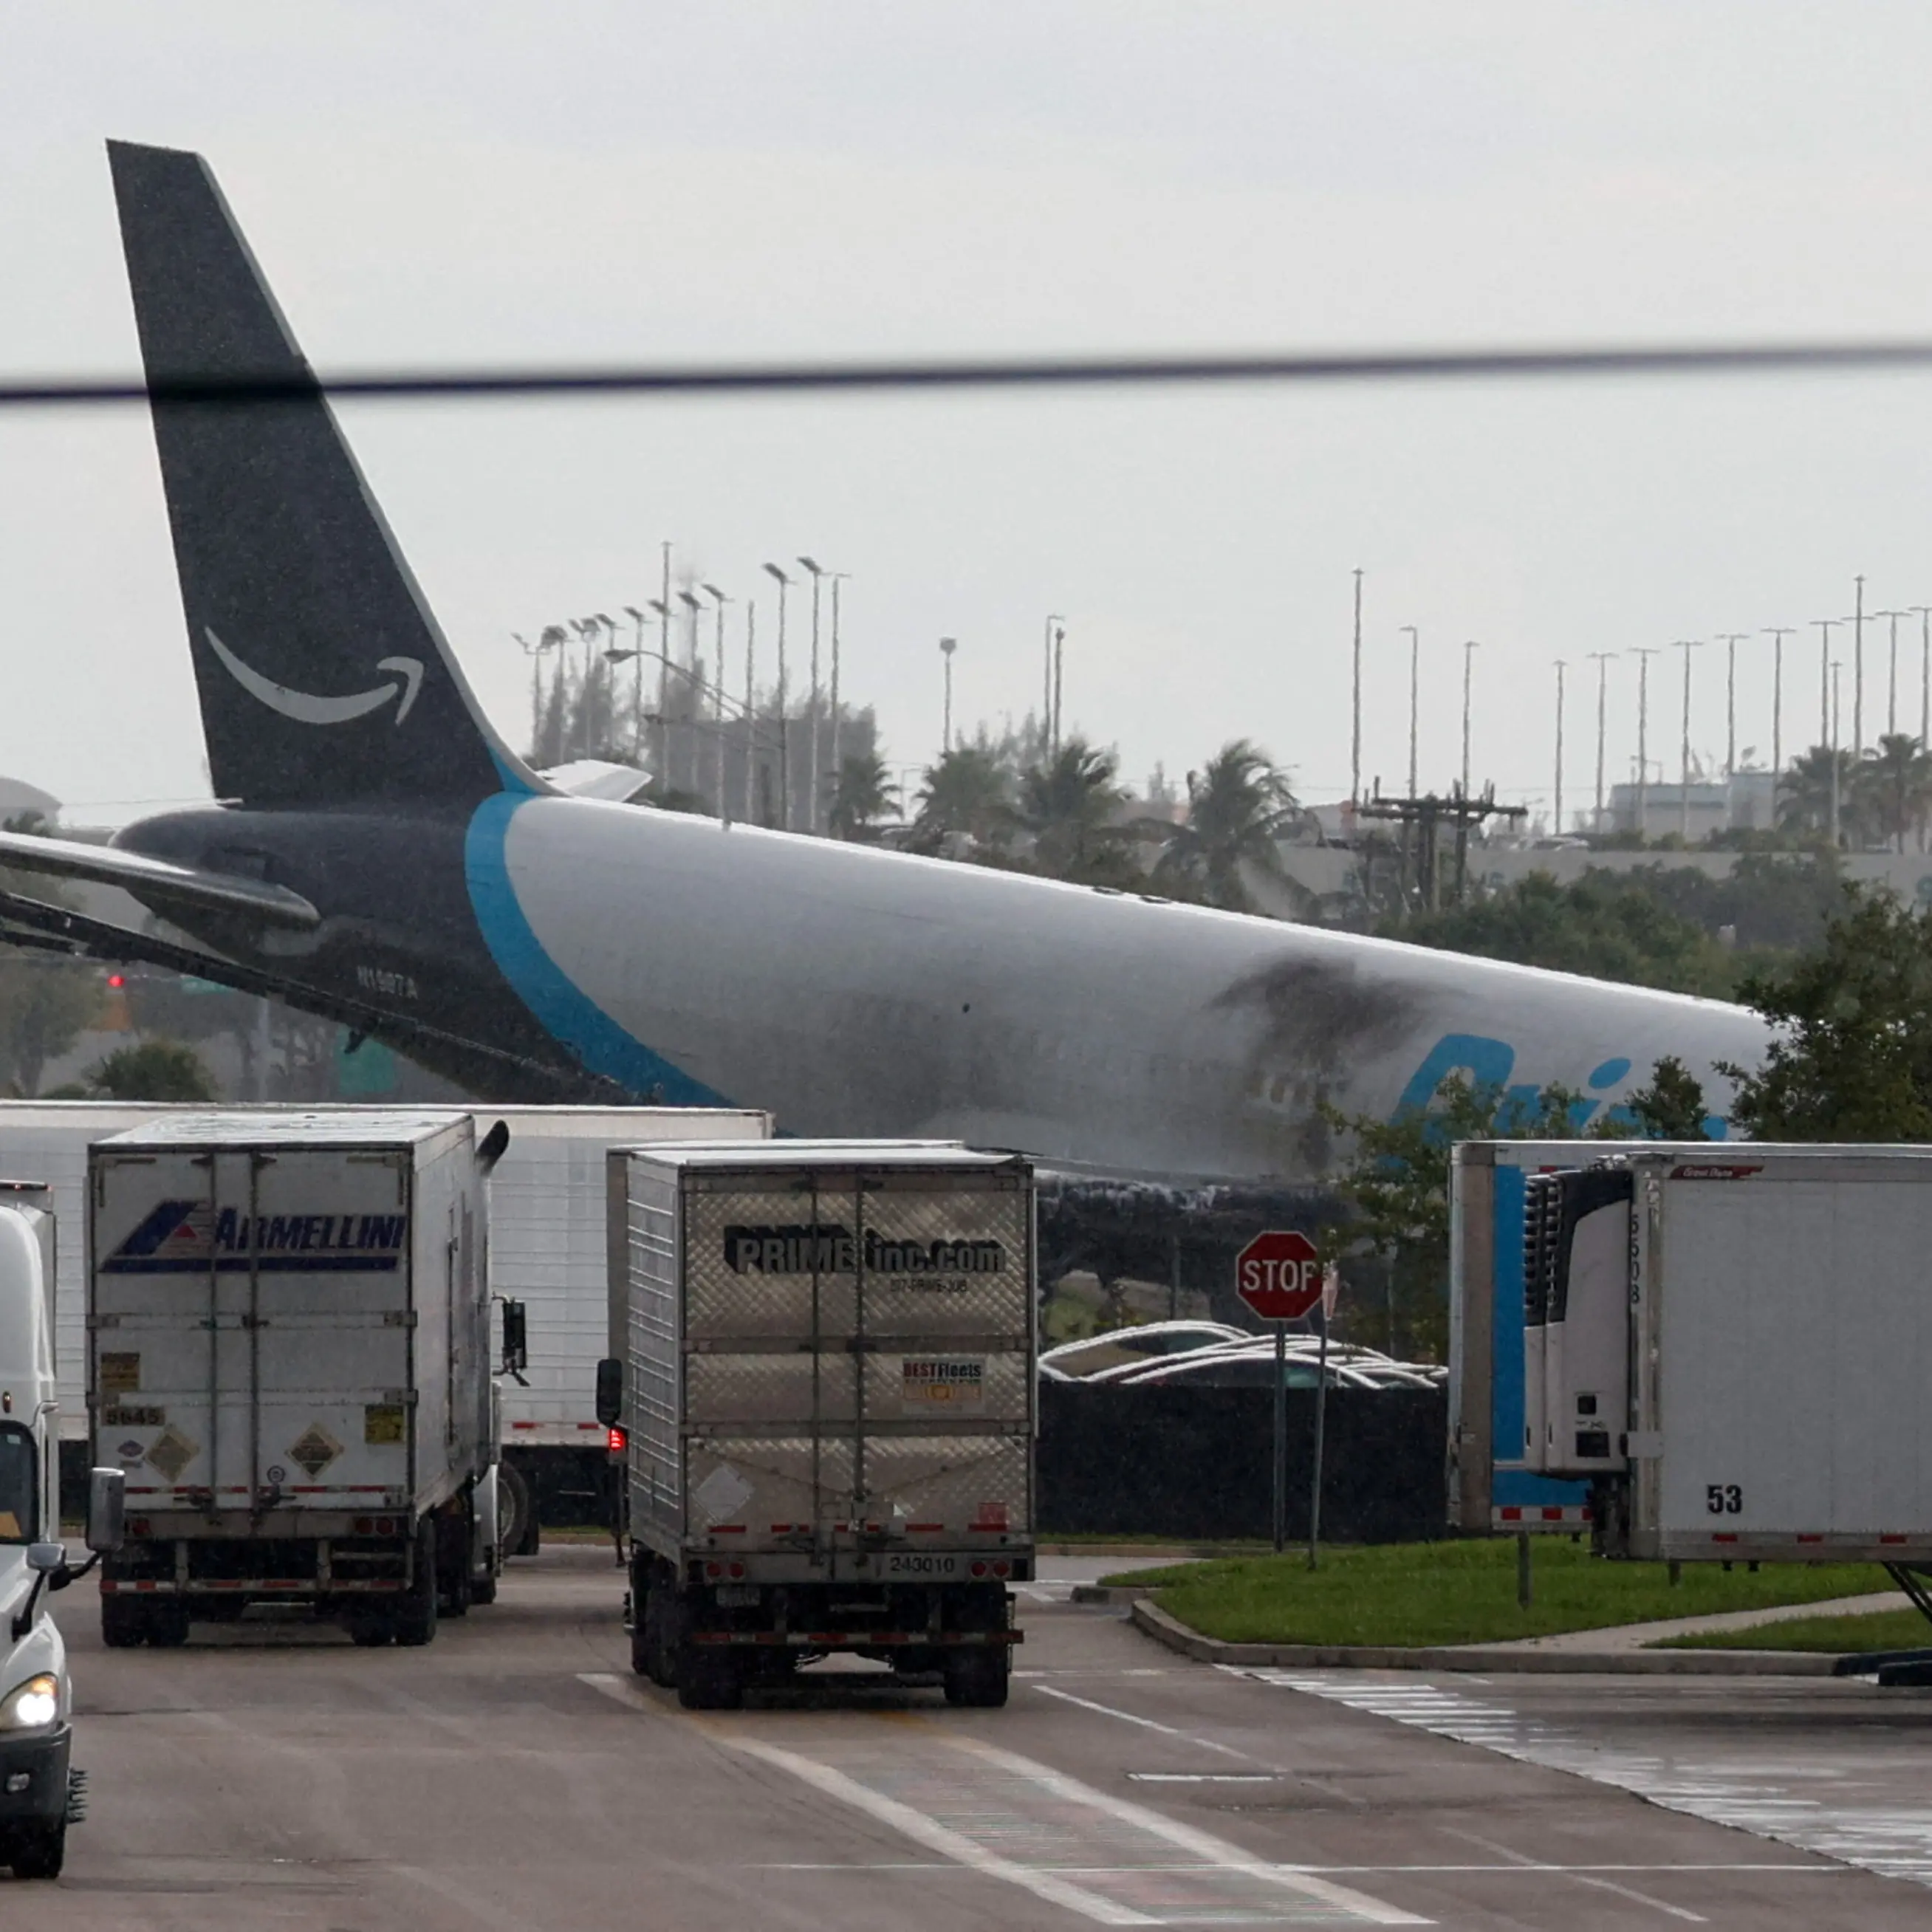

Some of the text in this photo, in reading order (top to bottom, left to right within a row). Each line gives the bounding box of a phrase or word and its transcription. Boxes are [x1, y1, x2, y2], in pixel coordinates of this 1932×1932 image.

[726, 1226, 855, 1272] PRIME
[1243, 1259, 1318, 1292] STOP
[1707, 1484, 1742, 1514] 53
